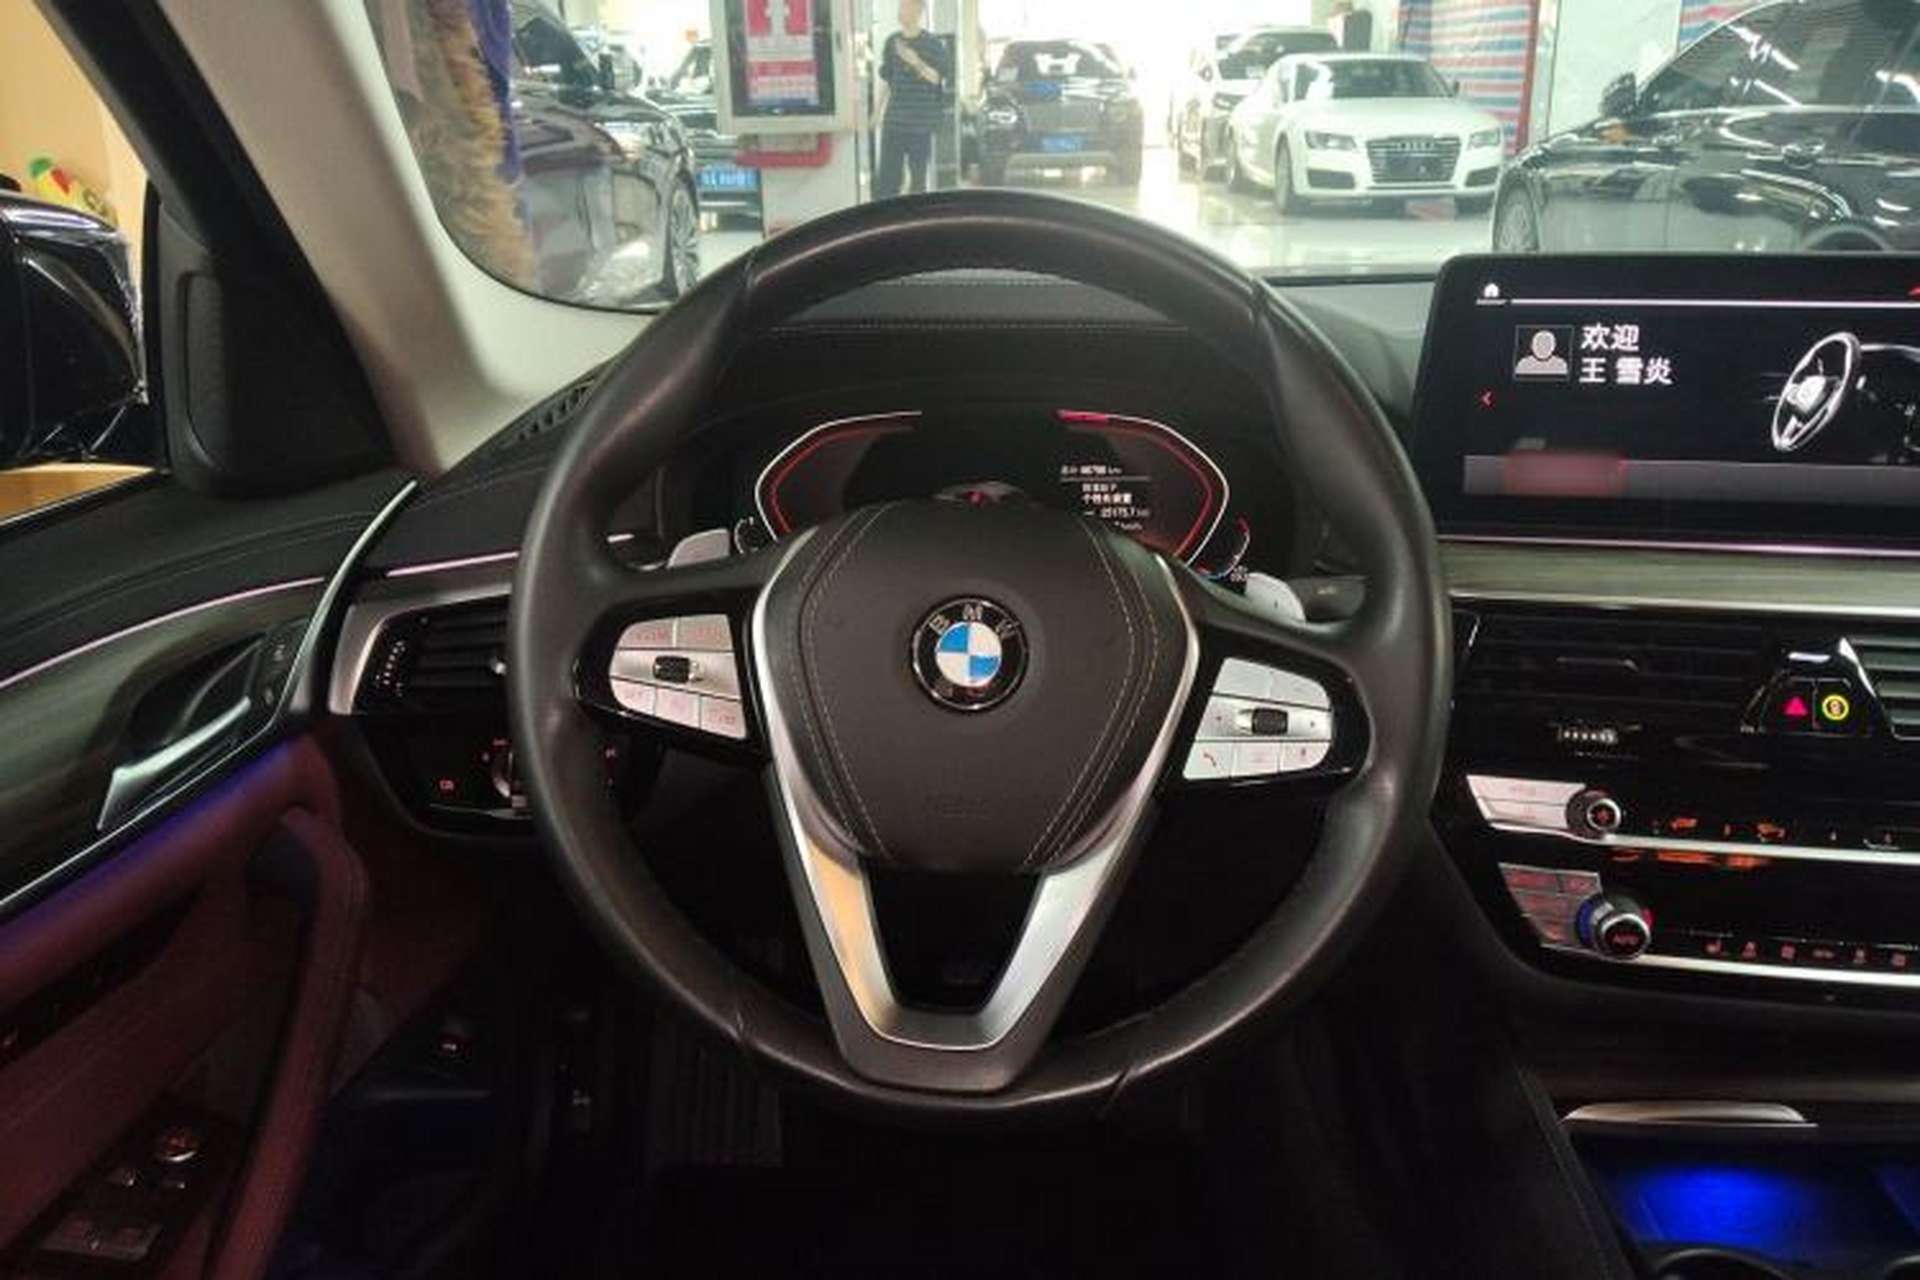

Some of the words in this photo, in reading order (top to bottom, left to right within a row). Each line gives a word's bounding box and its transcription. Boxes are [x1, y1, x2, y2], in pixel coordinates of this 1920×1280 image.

[1581, 324, 1640, 351] 欢迎
[1579, 357, 1607, 383] 王
[1615, 356, 1673, 385] 雪炎
[928, 604, 1020, 640] BMW
